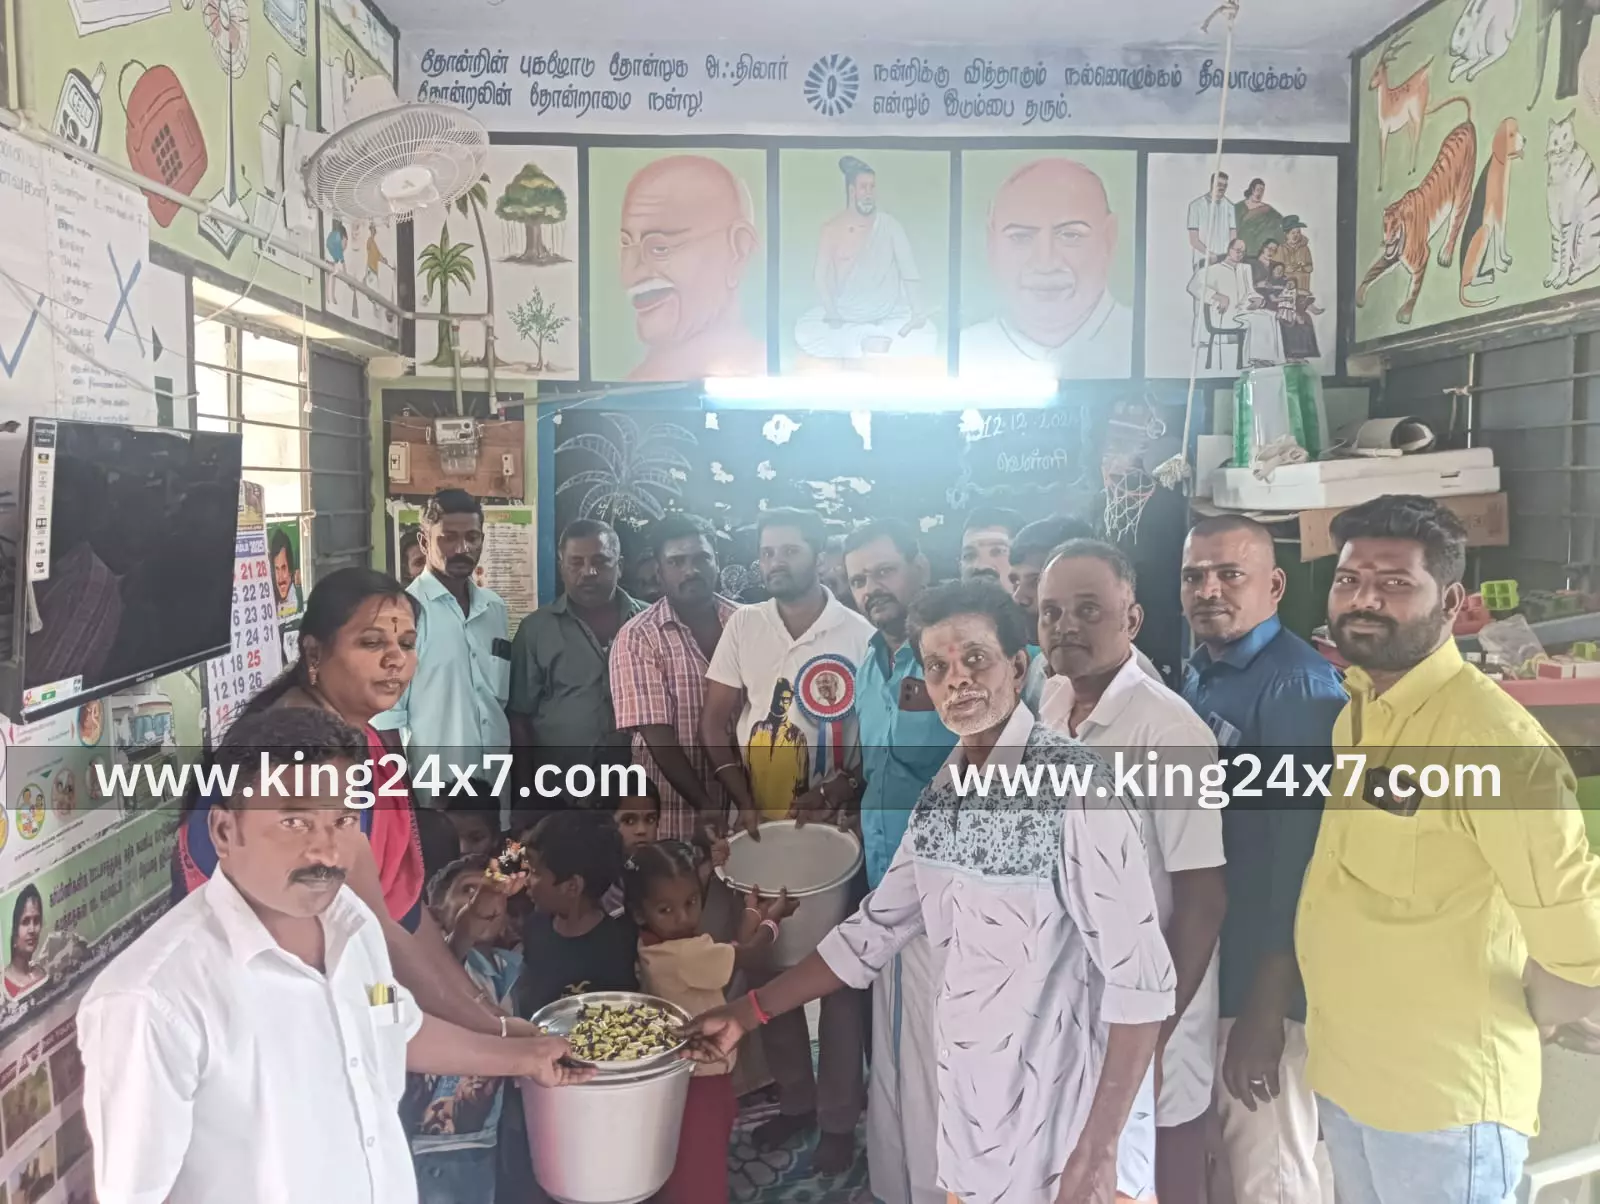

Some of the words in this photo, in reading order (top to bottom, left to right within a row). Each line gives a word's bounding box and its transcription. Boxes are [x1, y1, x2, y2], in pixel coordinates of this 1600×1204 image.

[421, 48, 509, 78] தோன்றின்
[520, 50, 596, 79] புகழோடு
[609, 51, 689, 82] தோன்றுக
[873, 56, 949, 88] நன்றிக்கு
[964, 58, 1047, 89] வித்தாகும்
[1064, 62, 1182, 90] நல்லொழுக்கம்
[530, 81, 632, 118] தோன்றாமை
[873, 91, 930, 118] என்றும்
[944, 88, 1015, 118] இடும்பை
[241, 563, 253, 580] 21
[256, 561, 268, 578] 28
[242, 585, 257, 601] 22
[259, 582, 270, 600] 29
[244, 606, 258, 624] 23
[261, 603, 273, 621] 30
[246, 628, 259, 646] 24
[263, 624, 274, 642] 31
[211, 660, 225, 678] 11
[230, 654, 243, 672] 18
[247, 650, 262, 669] 25
[214, 682, 229, 701] 12
[232, 676, 245, 695] 19
[249, 671, 262, 690] 26
